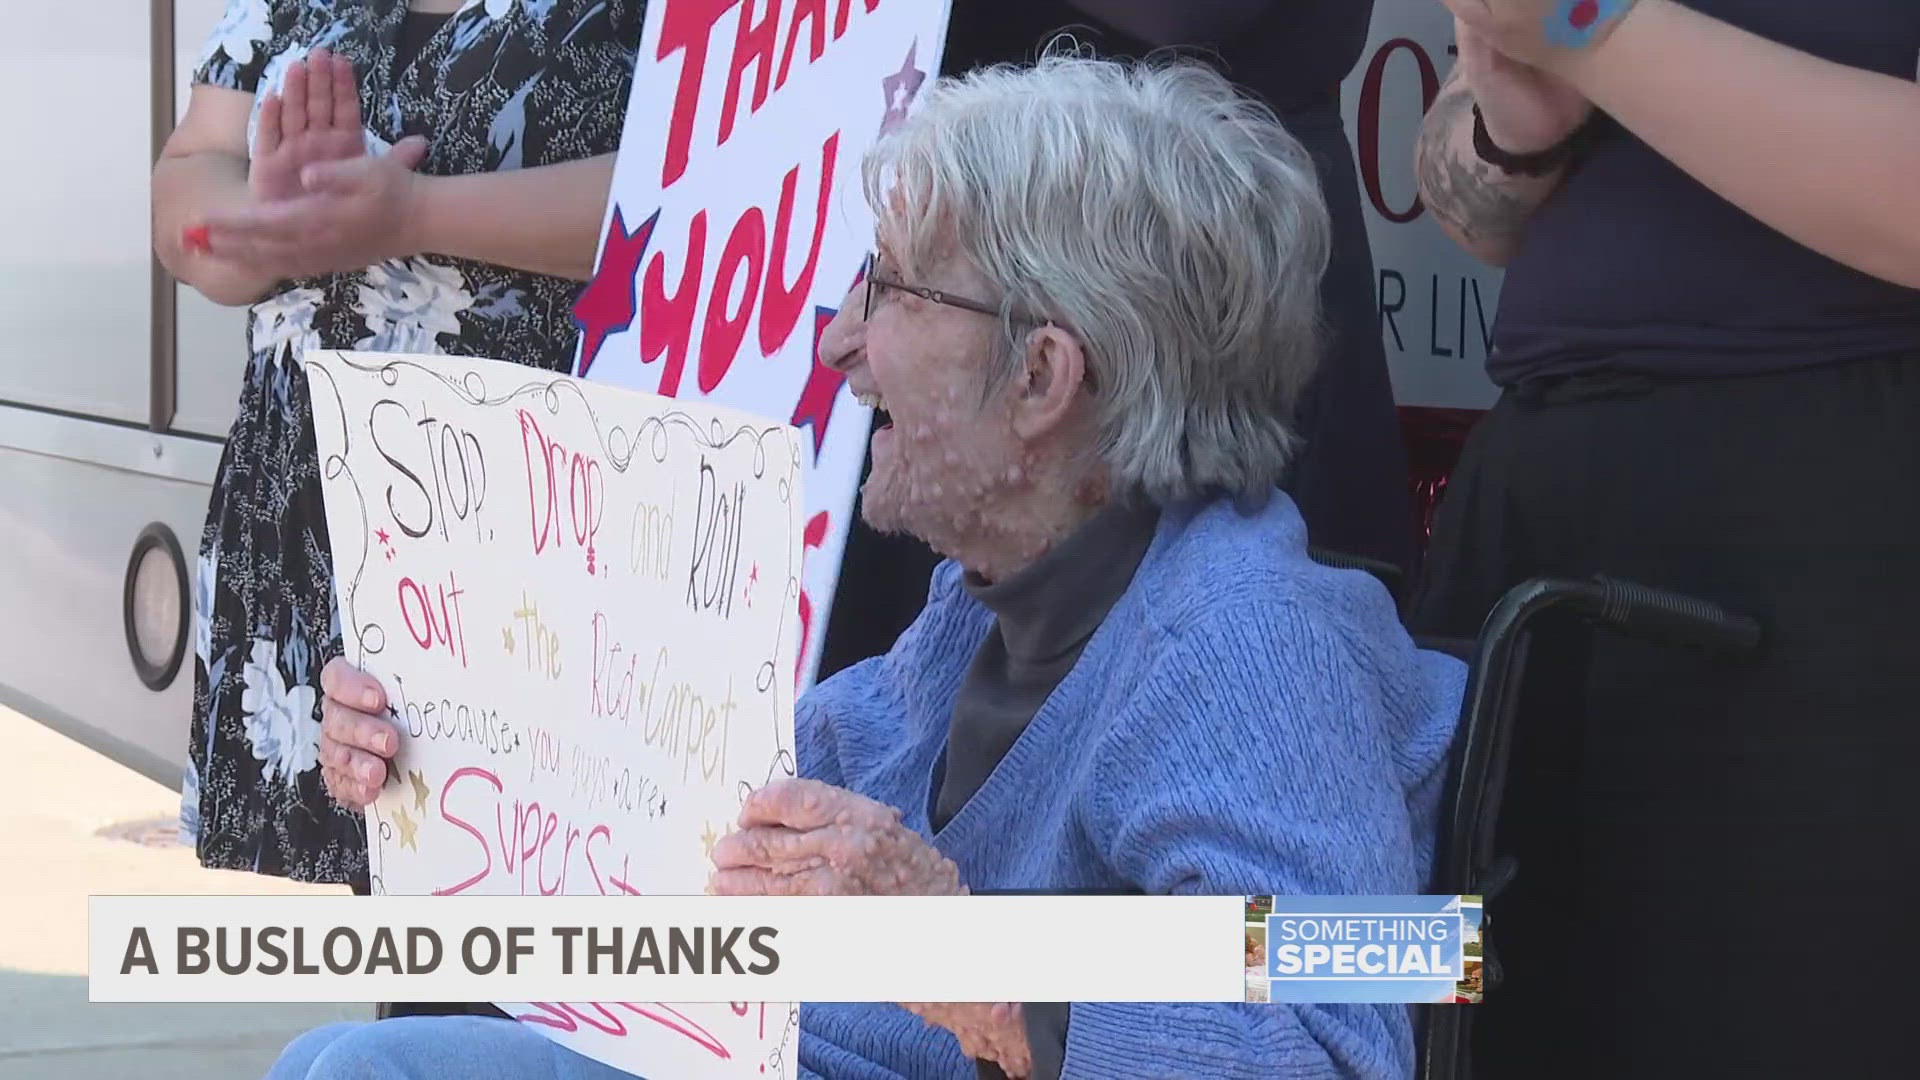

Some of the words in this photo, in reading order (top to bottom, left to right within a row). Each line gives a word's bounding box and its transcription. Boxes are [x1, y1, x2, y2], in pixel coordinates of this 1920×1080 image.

[640, 129, 841, 398] YOU
[630, 479, 677, 581] and
[686, 454, 746, 620] Roll
[393, 673, 512, 755] because
[528, 726, 560, 782] you
[571, 744, 610, 810] guys
[618, 767, 658, 820] are
[513, 589, 562, 681] the
[643, 645, 737, 787] Carpet
